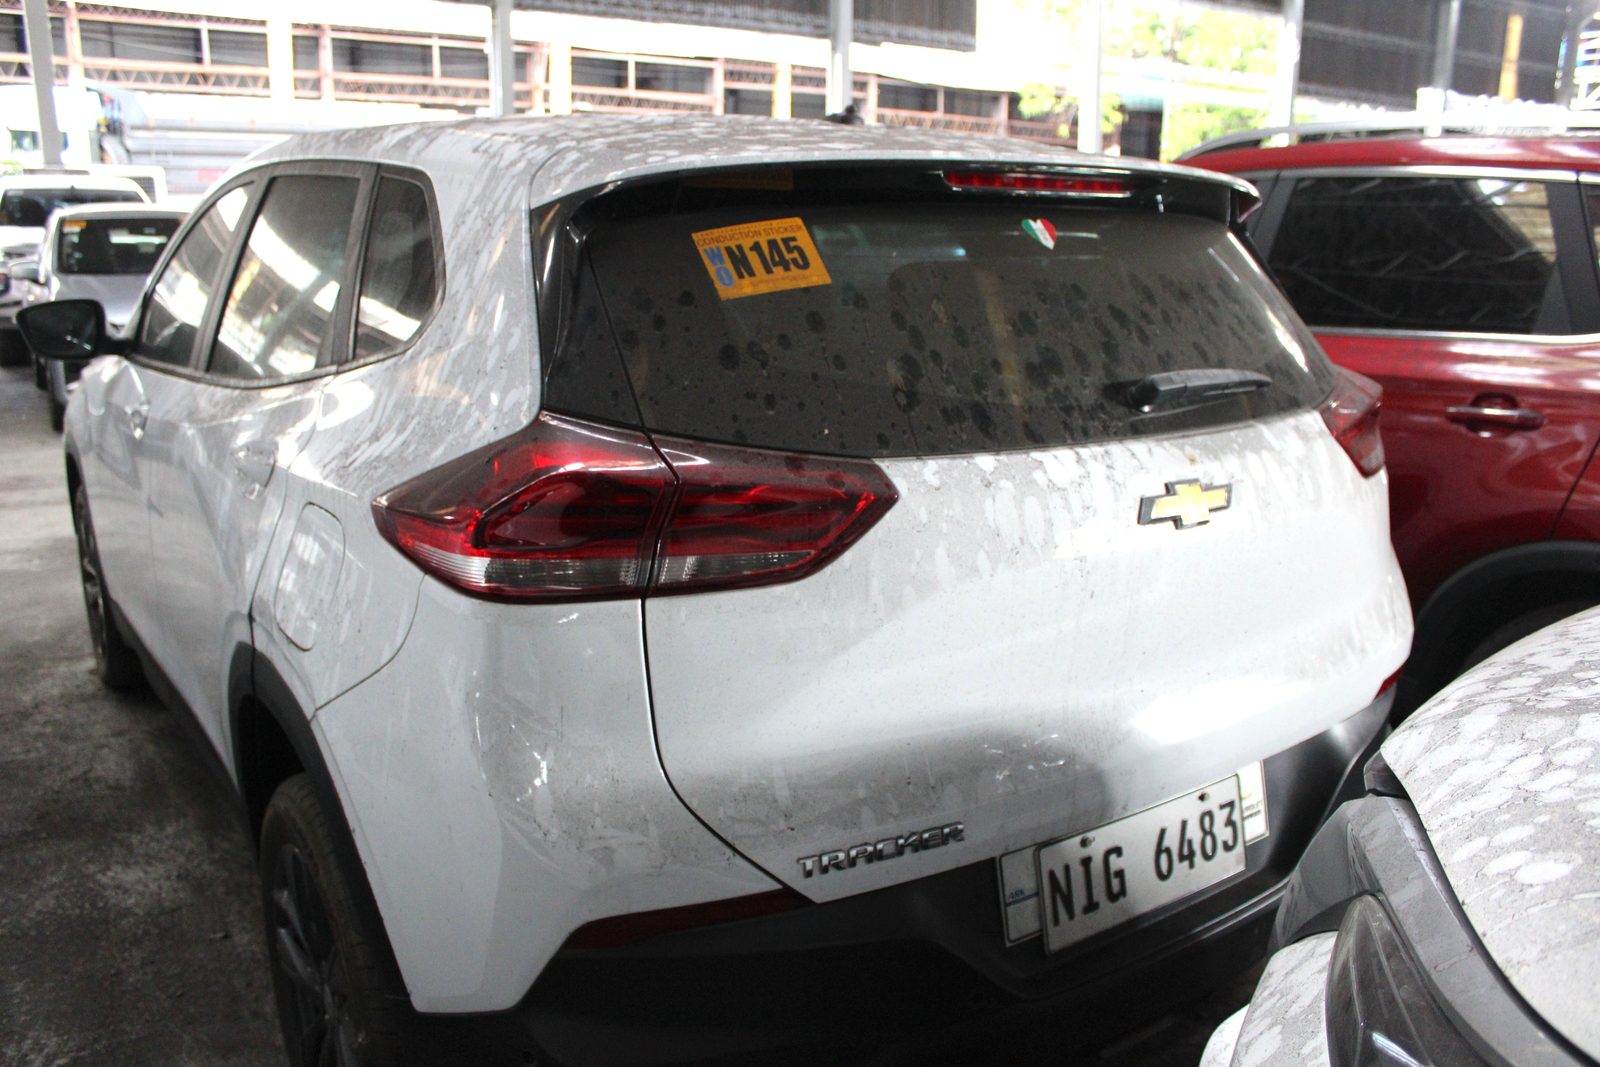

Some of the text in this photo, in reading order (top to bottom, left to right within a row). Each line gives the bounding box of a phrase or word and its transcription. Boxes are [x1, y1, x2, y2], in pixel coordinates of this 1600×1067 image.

[696, 229, 762, 247] CONDUCTION
[764, 224, 802, 236] STICKER
[797, 821, 965, 878] TRACKER
[1048, 800, 1238, 927] NIG 6483
